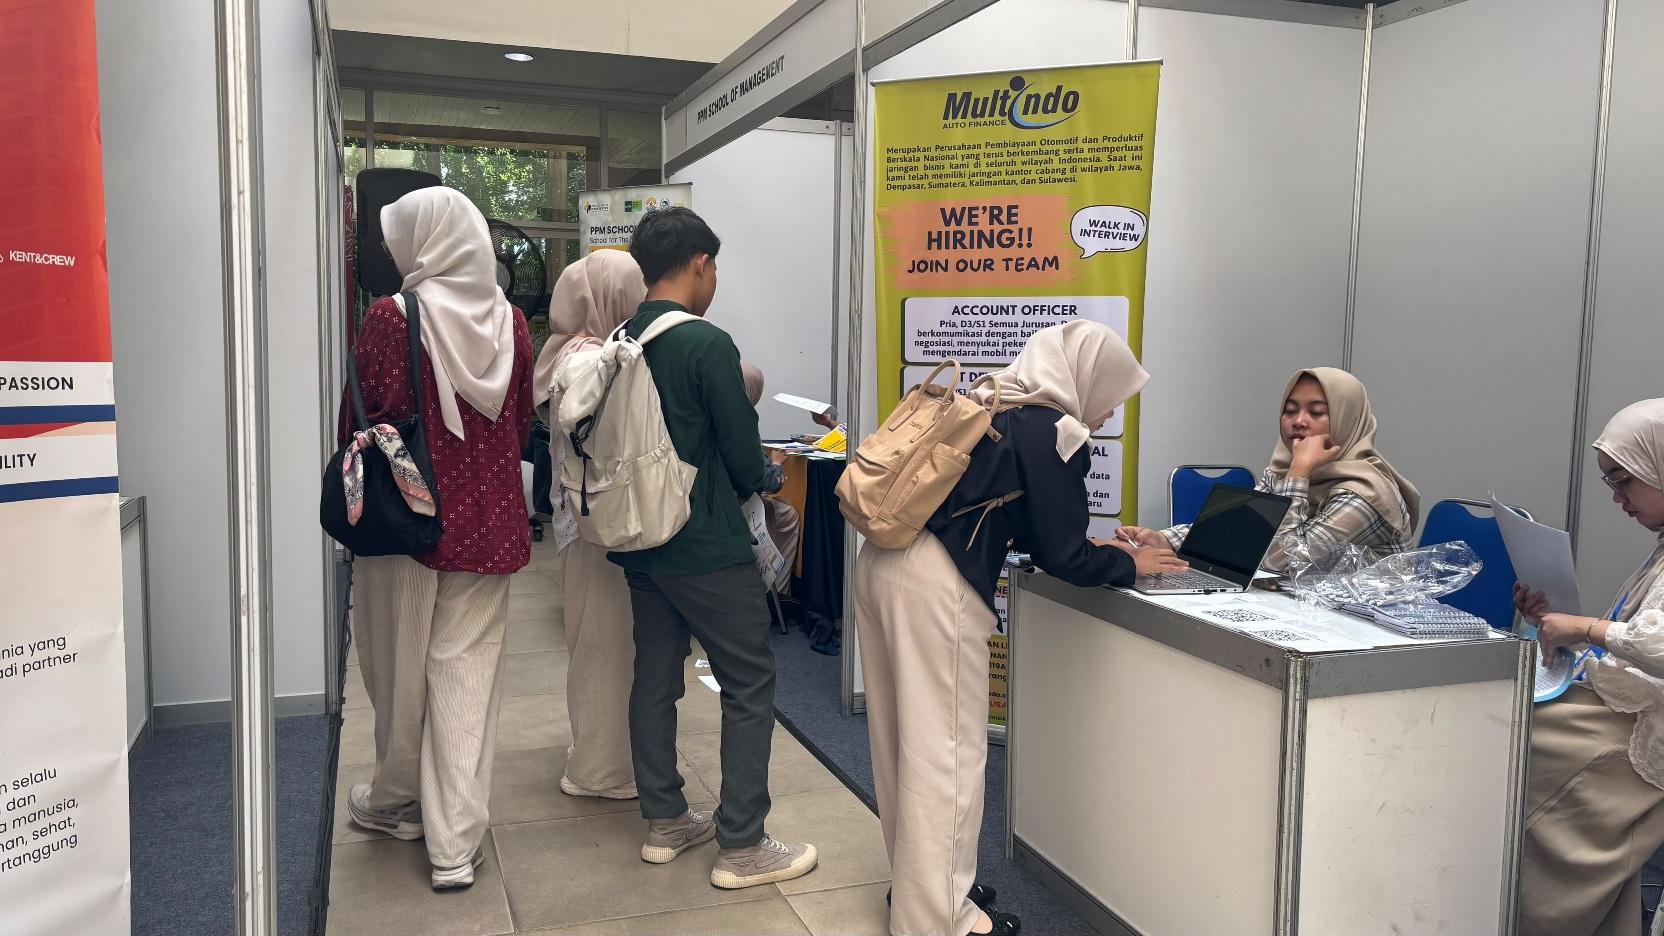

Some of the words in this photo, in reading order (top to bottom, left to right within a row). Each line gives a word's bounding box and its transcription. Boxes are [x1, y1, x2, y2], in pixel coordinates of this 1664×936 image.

[697, 107, 708, 125] PPM
[708, 92, 729, 118] SCHOOL
[730, 86, 738, 102] OF
[740, 55, 784, 97] MANAGEMENT
[943, 77, 1080, 125] Multindo
[943, 122, 966, 130] AUTO
[969, 120, 1006, 128] FINANCE
[886, 145, 932, 155] Merupakan
[935, 143, 981, 152] Perusahaan
[985, 140, 1036, 149] Pembiayaan
[1040, 136, 1078, 146] Otomotif
[1082, 136, 1098, 144] dan
[1102, 134, 1144, 143] Produktif
[886, 155, 920, 164] Berskala
[924, 153, 958, 162] Nasional
[961, 153, 980, 162] yang
[1006, 148, 1060, 158] berkembang
[1088, 144, 1143, 154] memperluas
[886, 164, 918, 174] jaringan
[924, 162, 946, 171] bisnis
[950, 162, 969, 170] kami
[974, 160, 981, 168] di
[986, 159, 1016, 168] seluruh
[1021, 157, 1054, 167] wilayah
[1058, 155, 1102, 164] Indonesia.
[1107, 154, 1126, 162] Saat
[1132, 152, 1142, 161] ini
[886, 174, 906, 182] kami
[908, 172, 928, 180] telah
[932, 170, 966, 180] memiliki
[968, 170, 1002, 180] jaringan
[1006, 168, 1032, 176] kantor
[1036, 166, 1066, 176] cabang
[1070, 165, 1078, 174] di
[1080, 164, 1114, 174] wilayah
[1118, 164, 1142, 172] Jawa,
[886, 182, 926, 192] Denpasar,
[928, 180, 968, 189] Sumatera,
[970, 178, 1018, 187] Kalimantan,
[1020, 176, 1036, 185] dan
[1038, 174, 1078, 184] Sulawesi.
[940, 205, 1018, 227] WE'RE
[590, 226, 606, 234] PPM
[1089, 219, 1122, 230] WALK
[1122, 222, 1135, 232] IN
[928, 227, 1032, 250] HIRING!!
[1080, 228, 1140, 242] INTERVIEW
[10, 250, 76, 267] KENT&CREW
[908, 259, 948, 274] JOIN
[956, 258, 994, 273] OUR
[1002, 256, 1060, 272] TEAM
[952, 305, 1018, 316] ACCOUNT
[1021, 304, 1078, 316] OFFICER
[940, 320, 958, 329] Pria,
[961, 320, 986, 328] D3/S1
[988, 320, 1018, 328] Semua
[914, 339, 955, 348] negosiasi,
[957, 340, 1000, 348] menyukai
[918, 330, 982, 338] berkomumikasi
[985, 330, 1018, 340] dengan
[922, 348, 979, 358] mengendarai
[982, 348, 1007, 357] mobil
[0, 376, 74, 390] PASSION
[1090, 472, 1110, 480] data
[1092, 490, 1110, 498] dan
[28, 636, 66, 656] yang
[22, 652, 78, 678] partner
[12, 768, 56, 790] selalu
[6, 794, 36, 812] dan
[12, 798, 78, 830] manusia,
[32, 816, 76, 840] sehat,
